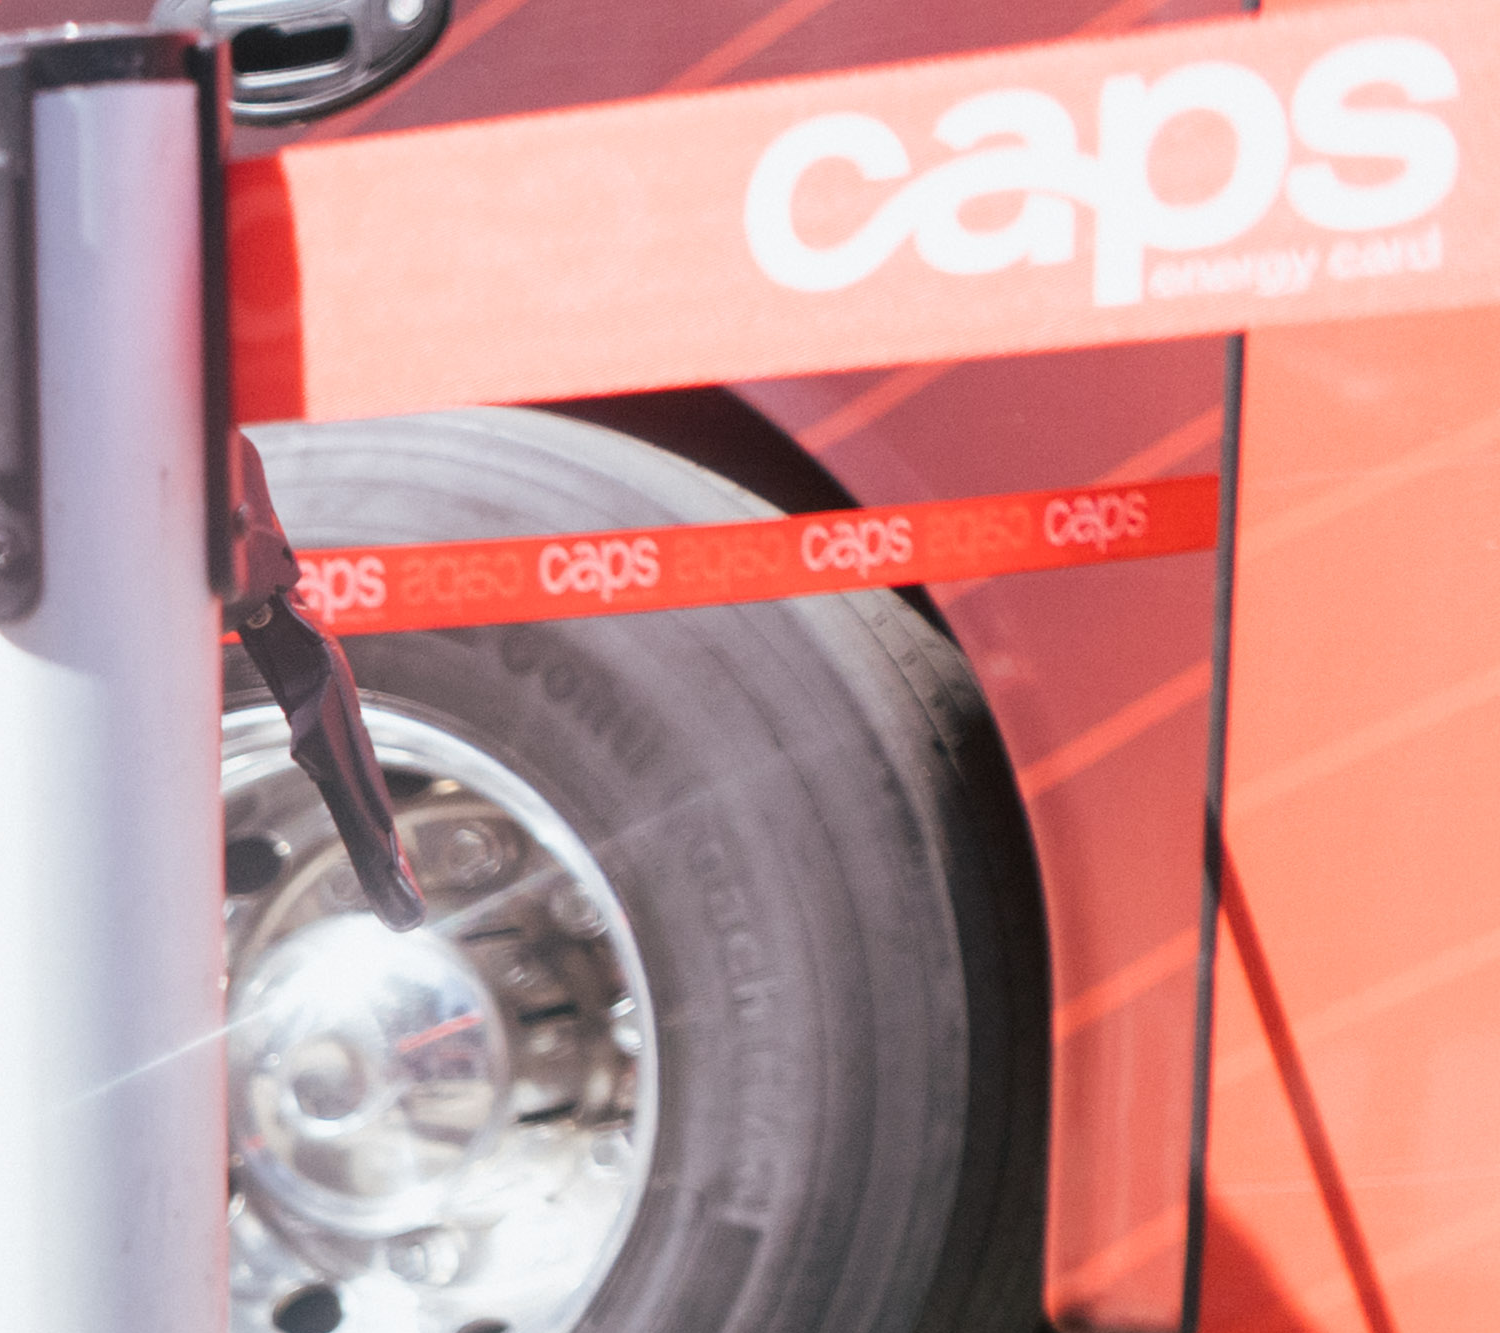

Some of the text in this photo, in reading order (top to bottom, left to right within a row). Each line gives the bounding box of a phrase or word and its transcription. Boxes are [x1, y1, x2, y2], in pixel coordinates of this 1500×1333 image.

[743, 35, 1460, 307] caps
[801, 513, 914, 580] caps
[1043, 490, 1150, 550] caps
[298, 549, 386, 616] aps
[537, 536, 661, 603] caps
